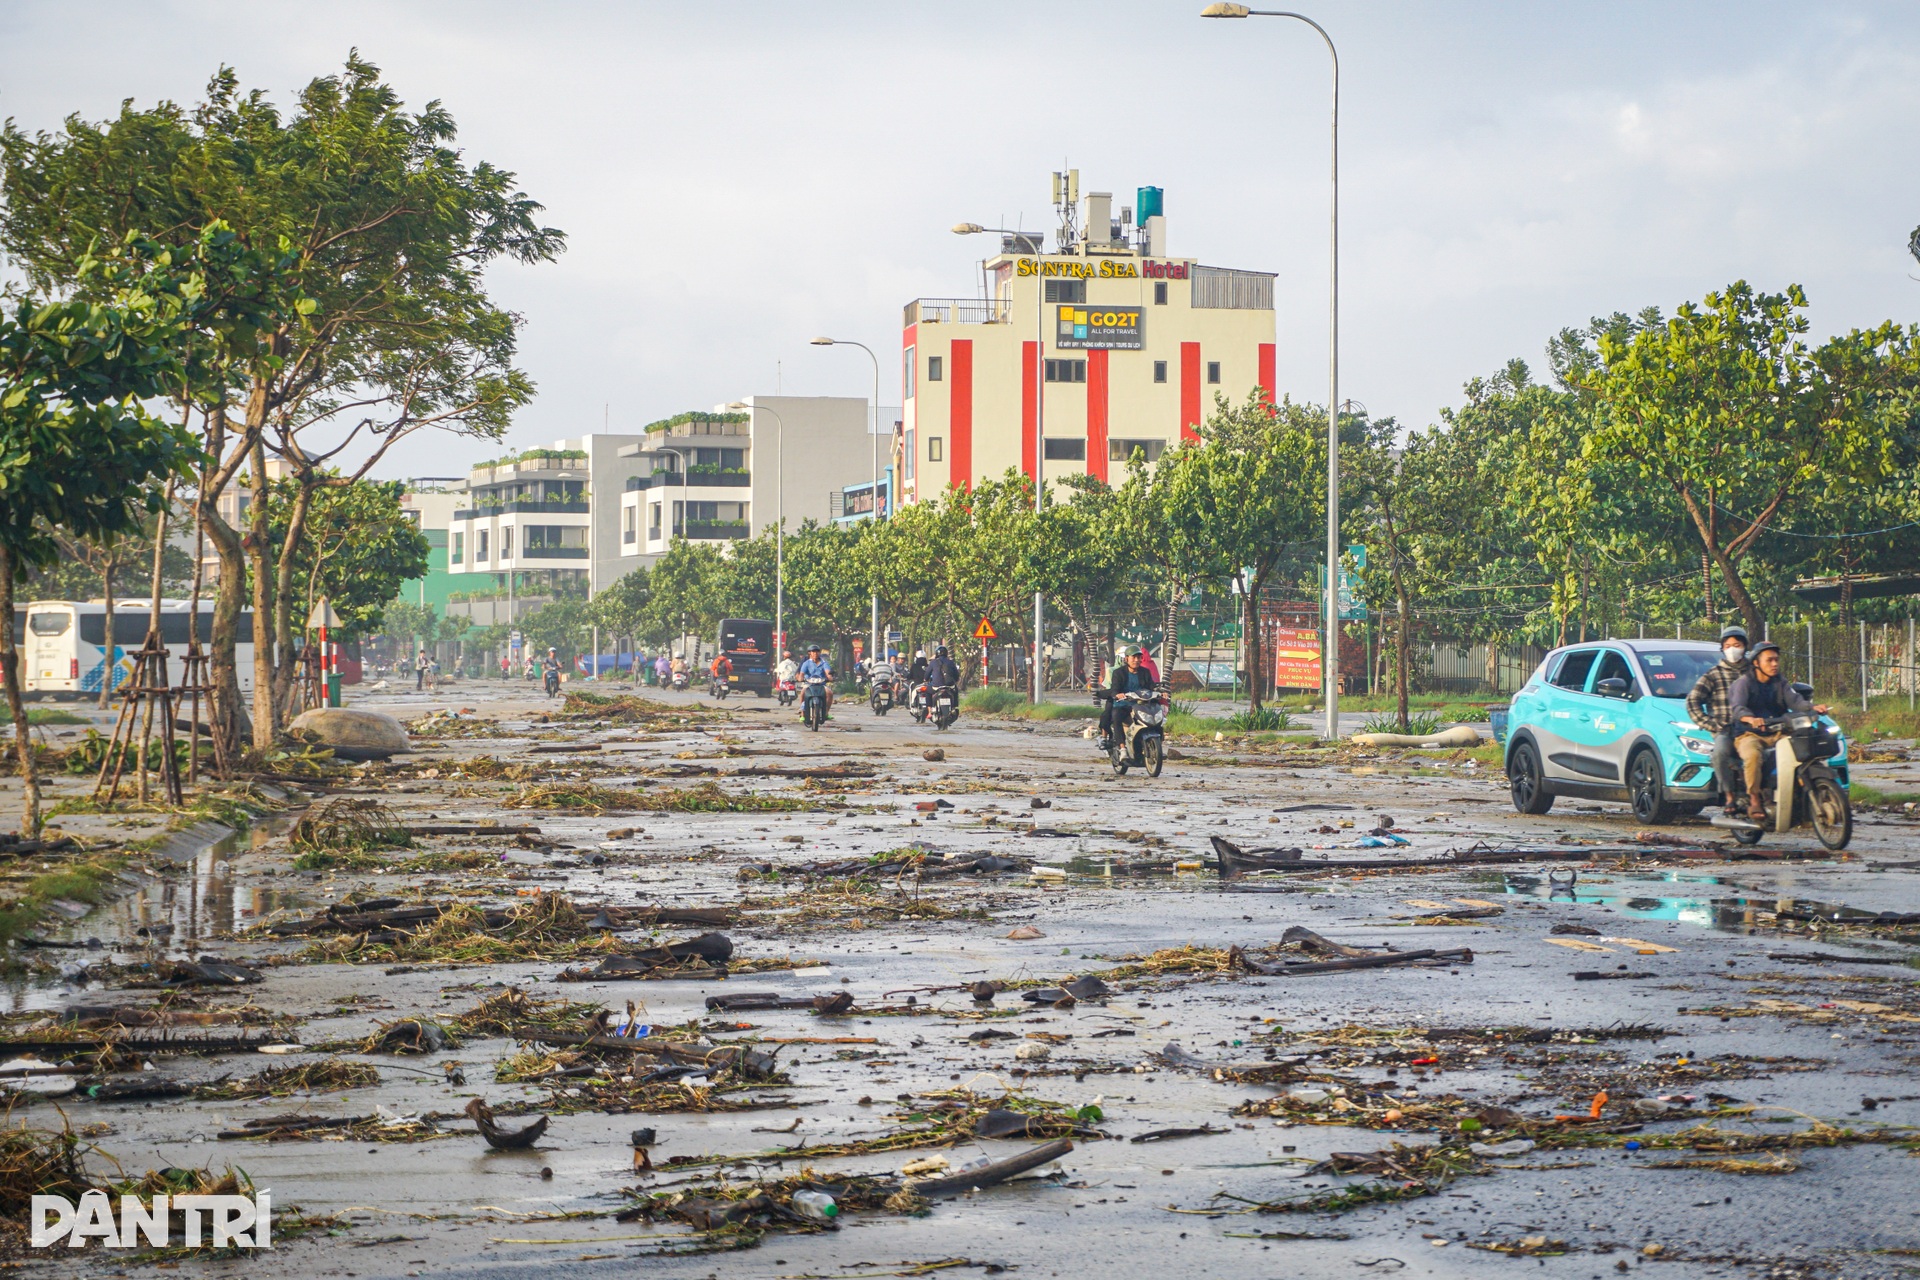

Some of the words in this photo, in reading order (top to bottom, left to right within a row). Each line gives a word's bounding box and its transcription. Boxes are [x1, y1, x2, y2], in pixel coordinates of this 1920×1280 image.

[1100, 260, 1139, 279] SEA
[1142, 259, 1190, 279] Hotel
[1090, 312, 1139, 327] GO2T
